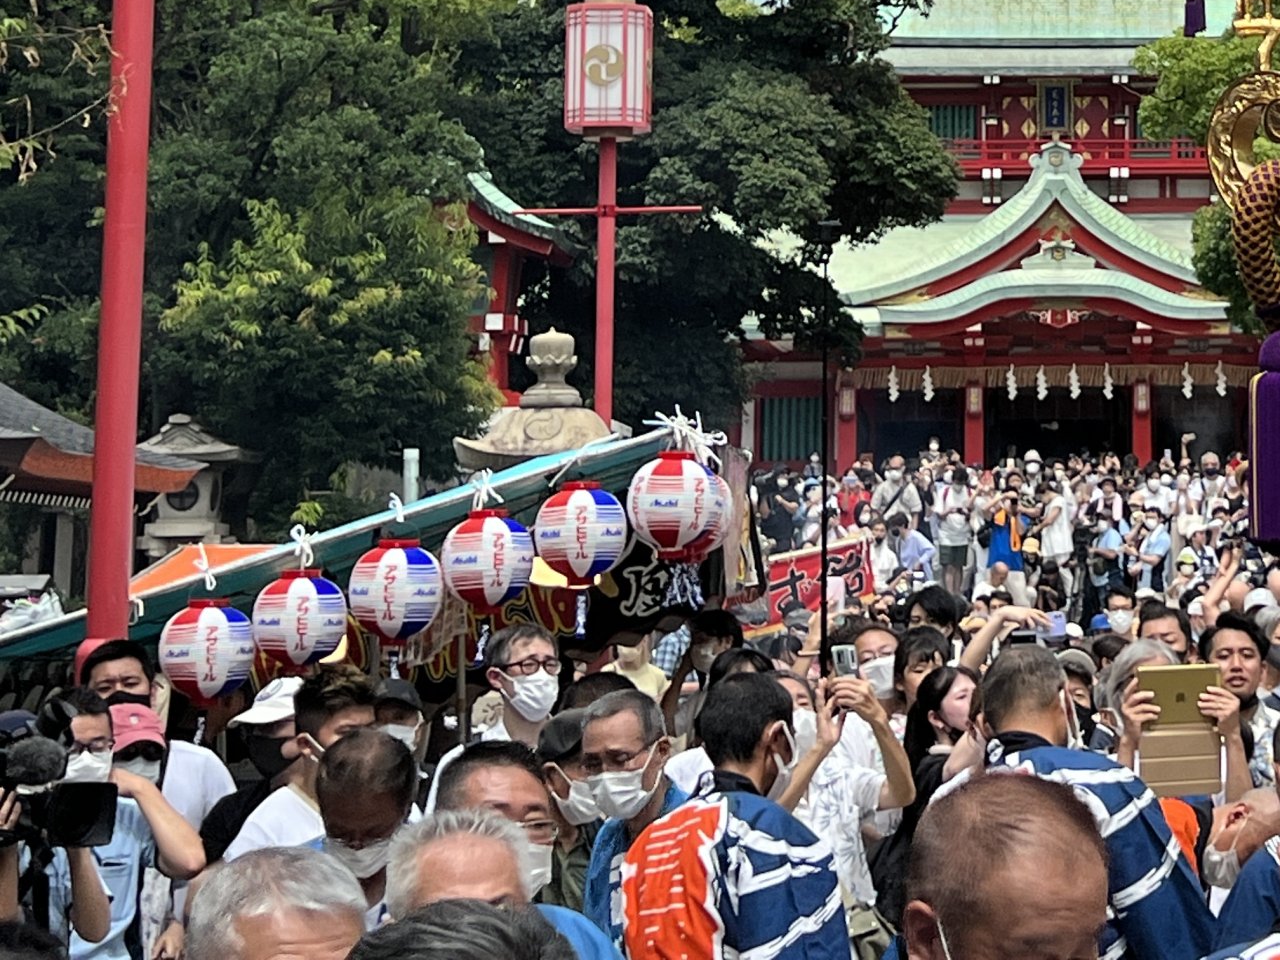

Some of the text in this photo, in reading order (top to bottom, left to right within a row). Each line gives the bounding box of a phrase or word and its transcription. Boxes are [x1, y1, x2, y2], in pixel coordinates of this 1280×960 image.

[688, 478, 704, 530] アサヒビール
[575, 506, 588, 559] アサヒビール
[490, 533, 505, 587] アサヒビール
[382, 565, 397, 620] アサヒビール
[294, 597, 309, 651] アサヒビール
[203, 626, 219, 682] アサヒビール
